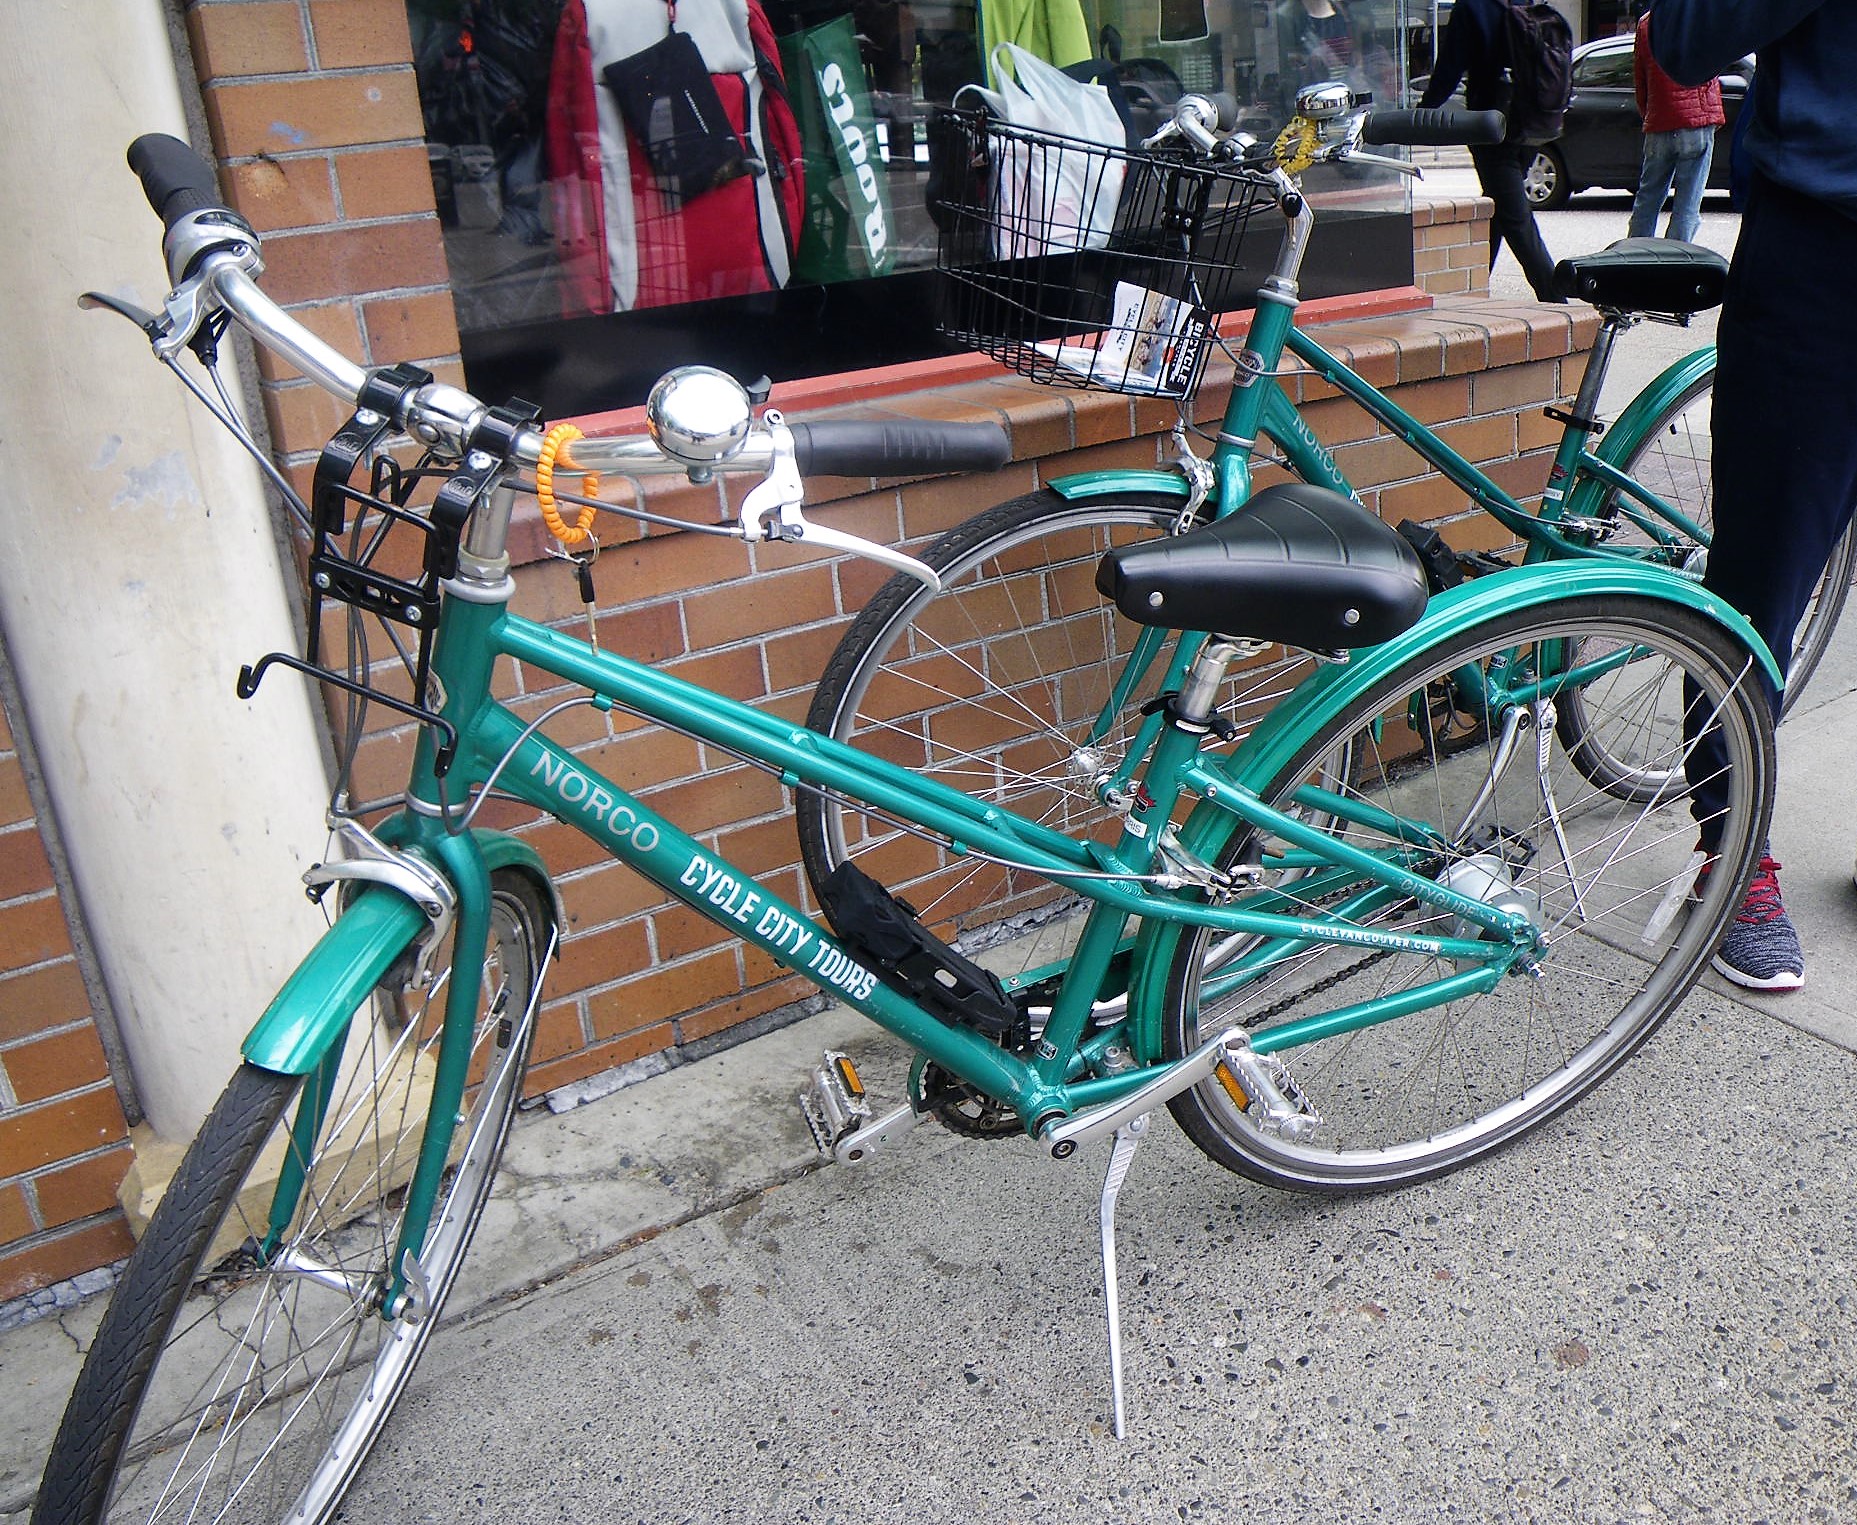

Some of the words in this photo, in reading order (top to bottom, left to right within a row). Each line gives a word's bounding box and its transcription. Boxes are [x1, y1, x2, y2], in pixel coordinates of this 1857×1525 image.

[530, 750, 660, 852] NORCO
[679, 854, 761, 924] CYCLE
[754, 905, 814, 956] CITY
[807, 938, 879, 1001] TOURS
